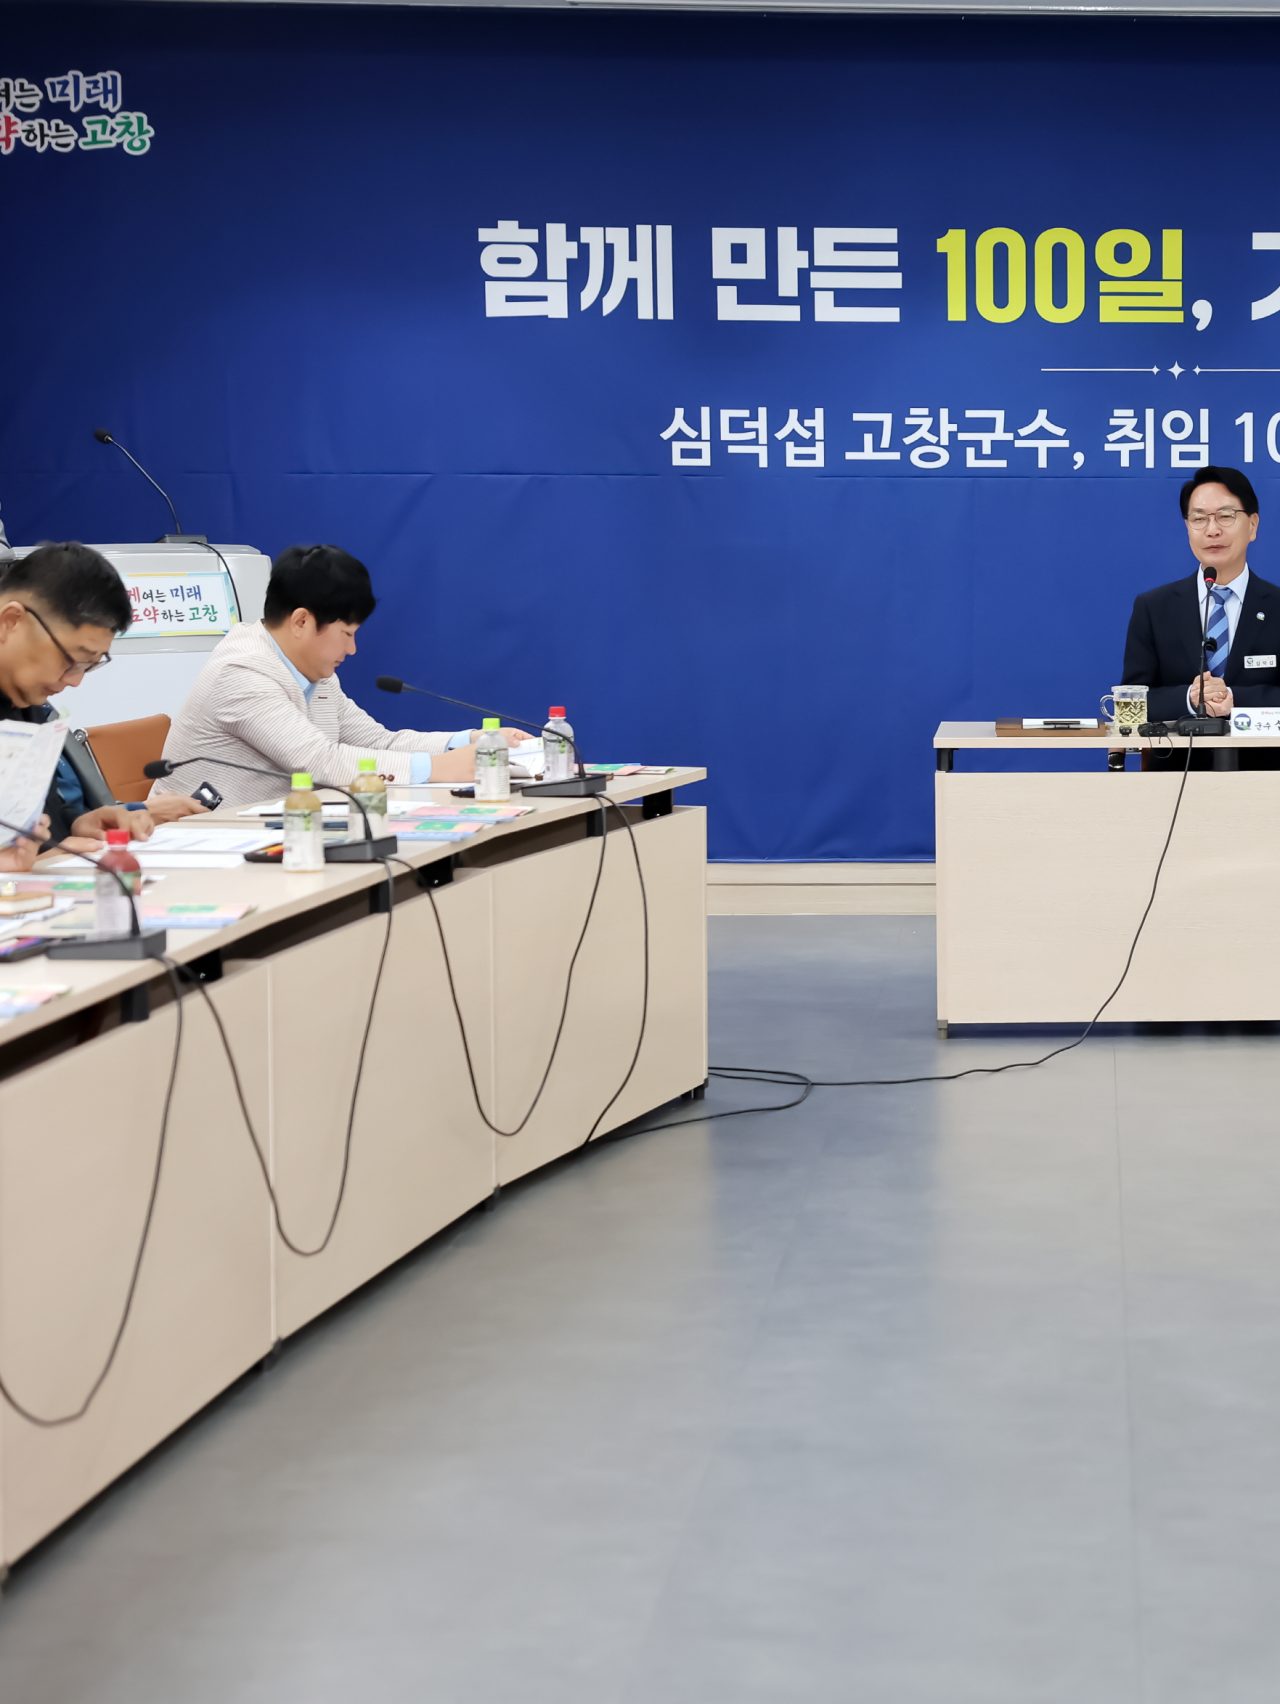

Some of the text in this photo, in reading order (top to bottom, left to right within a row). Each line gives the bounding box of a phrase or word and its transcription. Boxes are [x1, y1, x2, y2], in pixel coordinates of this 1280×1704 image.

[46, 71, 121, 111] 미래
[80, 113, 154, 155] 고창
[477, 220, 674, 320] 함께
[711, 226, 903, 323] 만든
[936, 226, 1213, 331] 100일,
[659, 406, 825, 468] 심덕섭
[844, 407, 1085, 470] 고창군수,
[1103, 408, 1210, 469] 취임
[169, 585, 202, 602] 미래
[188, 604, 219, 623] 고창
